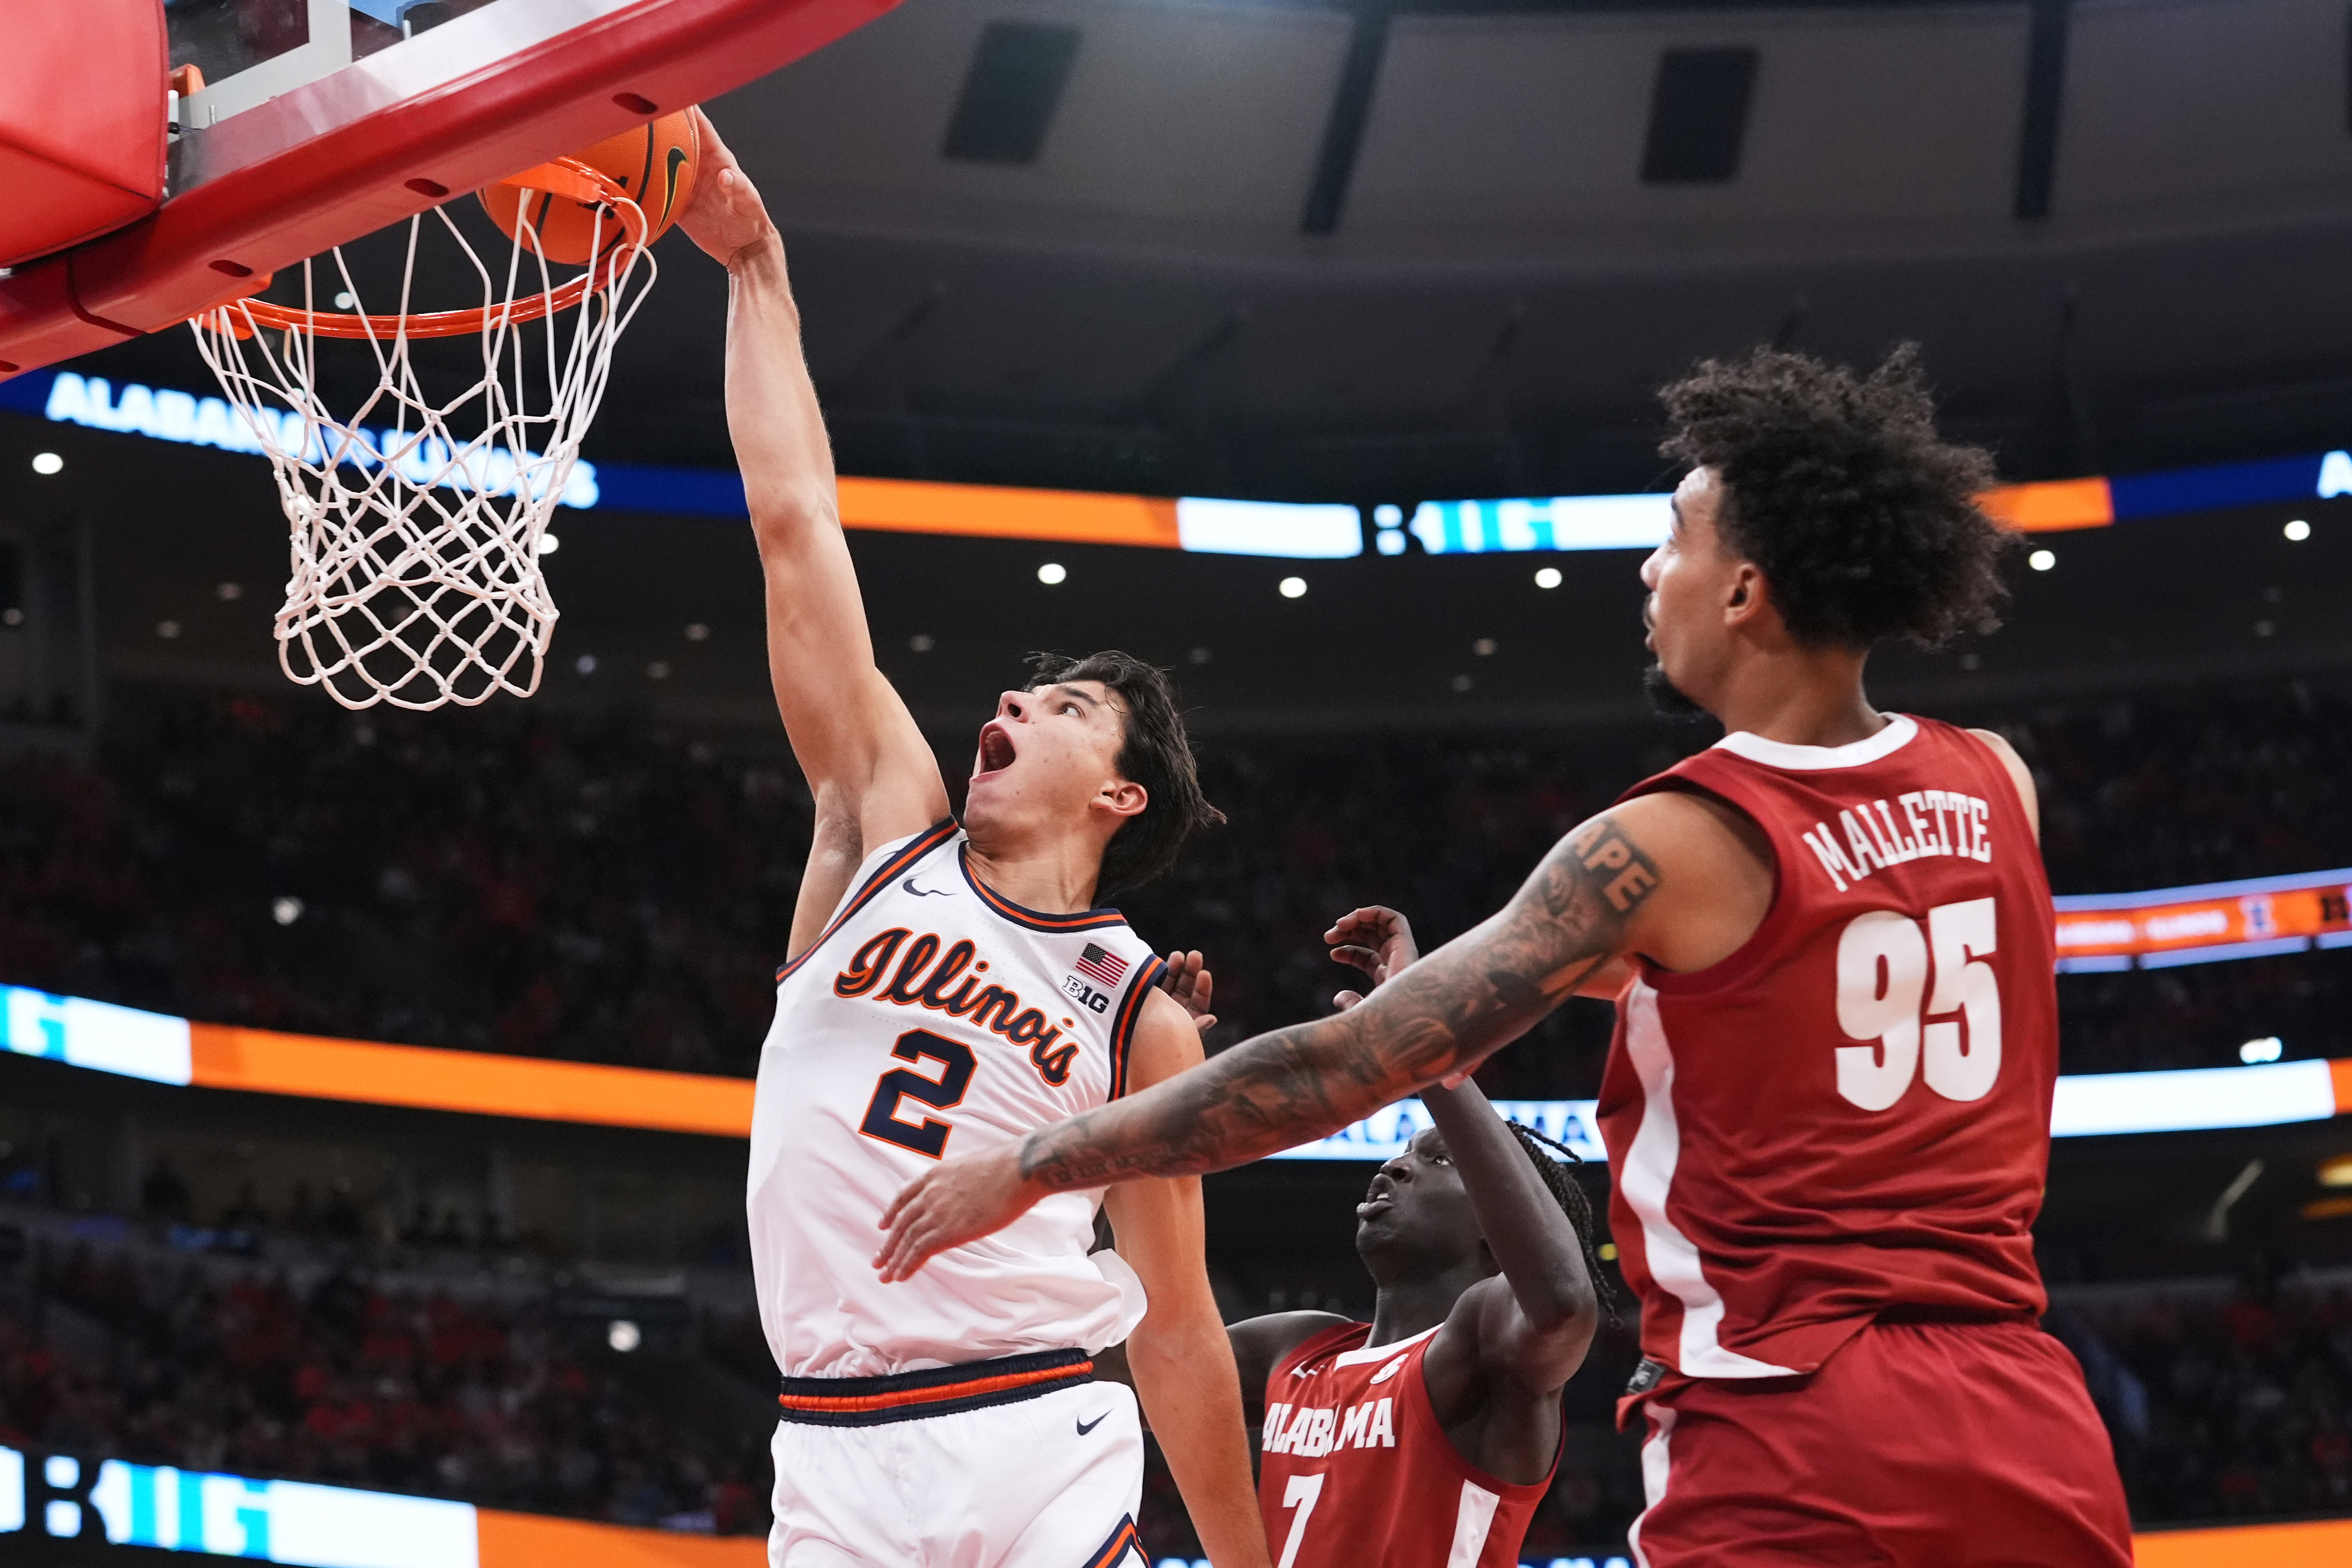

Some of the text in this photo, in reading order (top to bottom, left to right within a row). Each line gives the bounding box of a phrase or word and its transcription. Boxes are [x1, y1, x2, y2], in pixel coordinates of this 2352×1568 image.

[1803, 790, 1992, 892] MALLETTE
[833, 927, 1079, 1087] Illinois
[1062, 975, 1110, 1014] BIG
[1834, 897, 2002, 1111] 95
[858, 1028, 978, 1160] 2
[1277, 1473, 1325, 1568] 7
